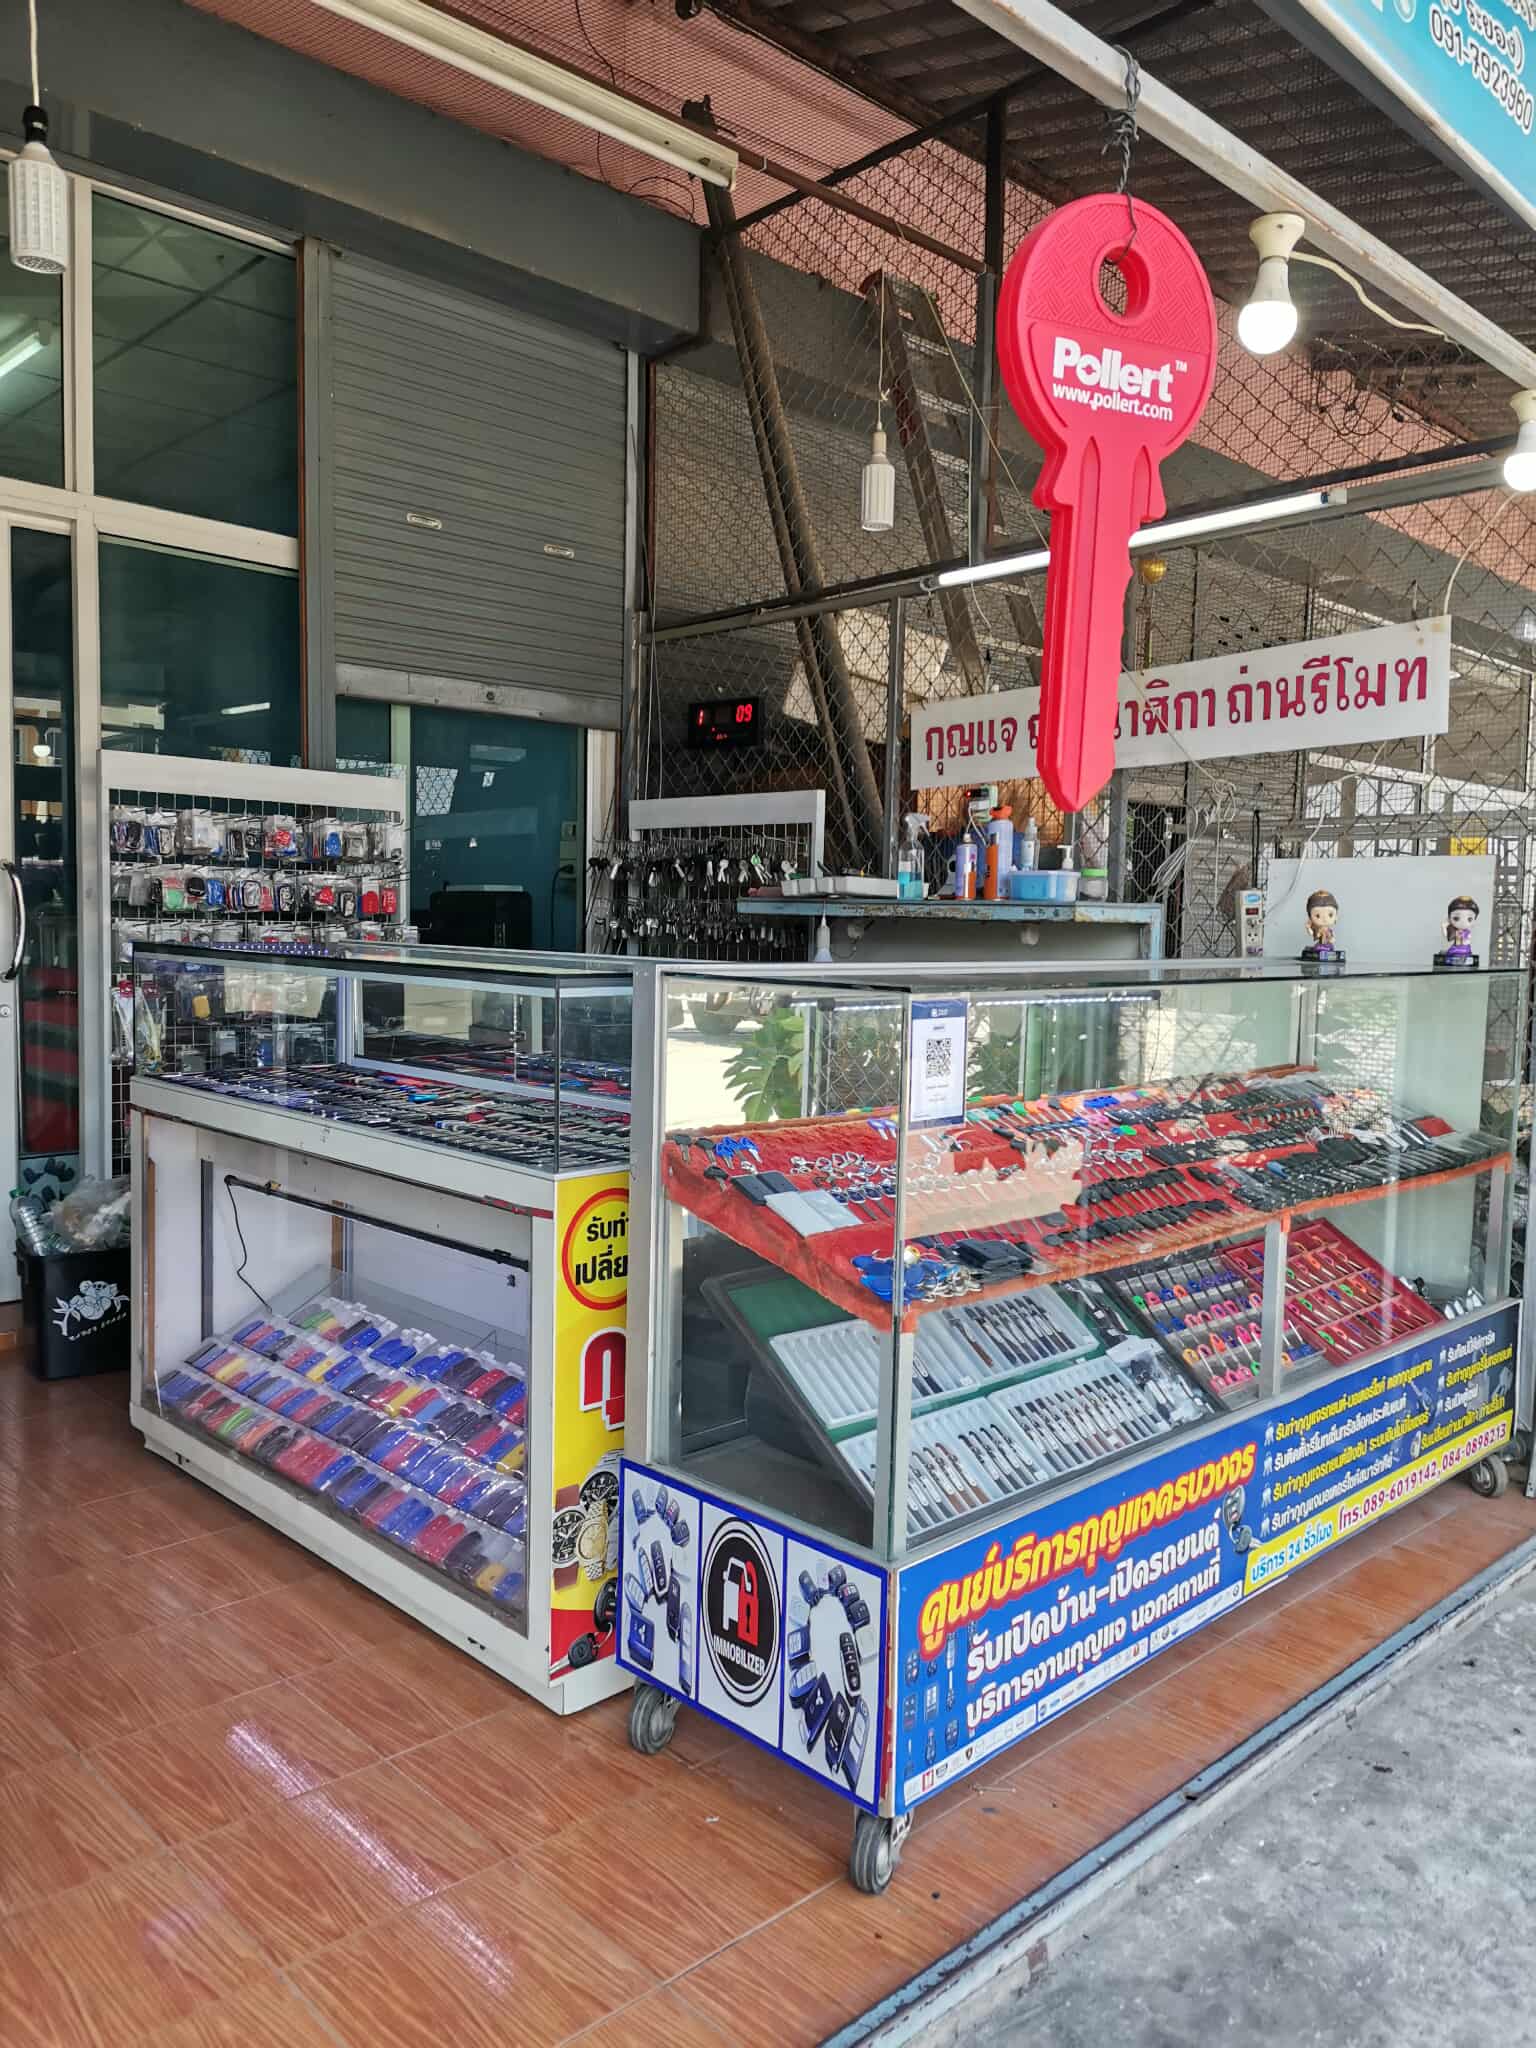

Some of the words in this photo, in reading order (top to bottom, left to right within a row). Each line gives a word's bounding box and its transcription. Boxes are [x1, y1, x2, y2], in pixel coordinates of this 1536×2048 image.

[1430, 7, 1534, 133] 091-7923960
[1052, 337, 1173, 402] Pollert
[1052, 383, 1174, 421] www.pollert.com
[924, 714, 1018, 776] กุญแจ
[1227, 654, 1428, 726] ถ่านรีโมท
[922, 1444, 1256, 1656] ศูนย์บริการกุญแจครบวงจร
[1251, 1549, 1285, 1582] บริการ
[1288, 1538, 1301, 1560] 24
[1303, 1520, 1333, 1551] ชั่วโมง
[1132, 1549, 1221, 1631] นอกสถานที่
[713, 1634, 766, 1676] IMMOBILIZER
